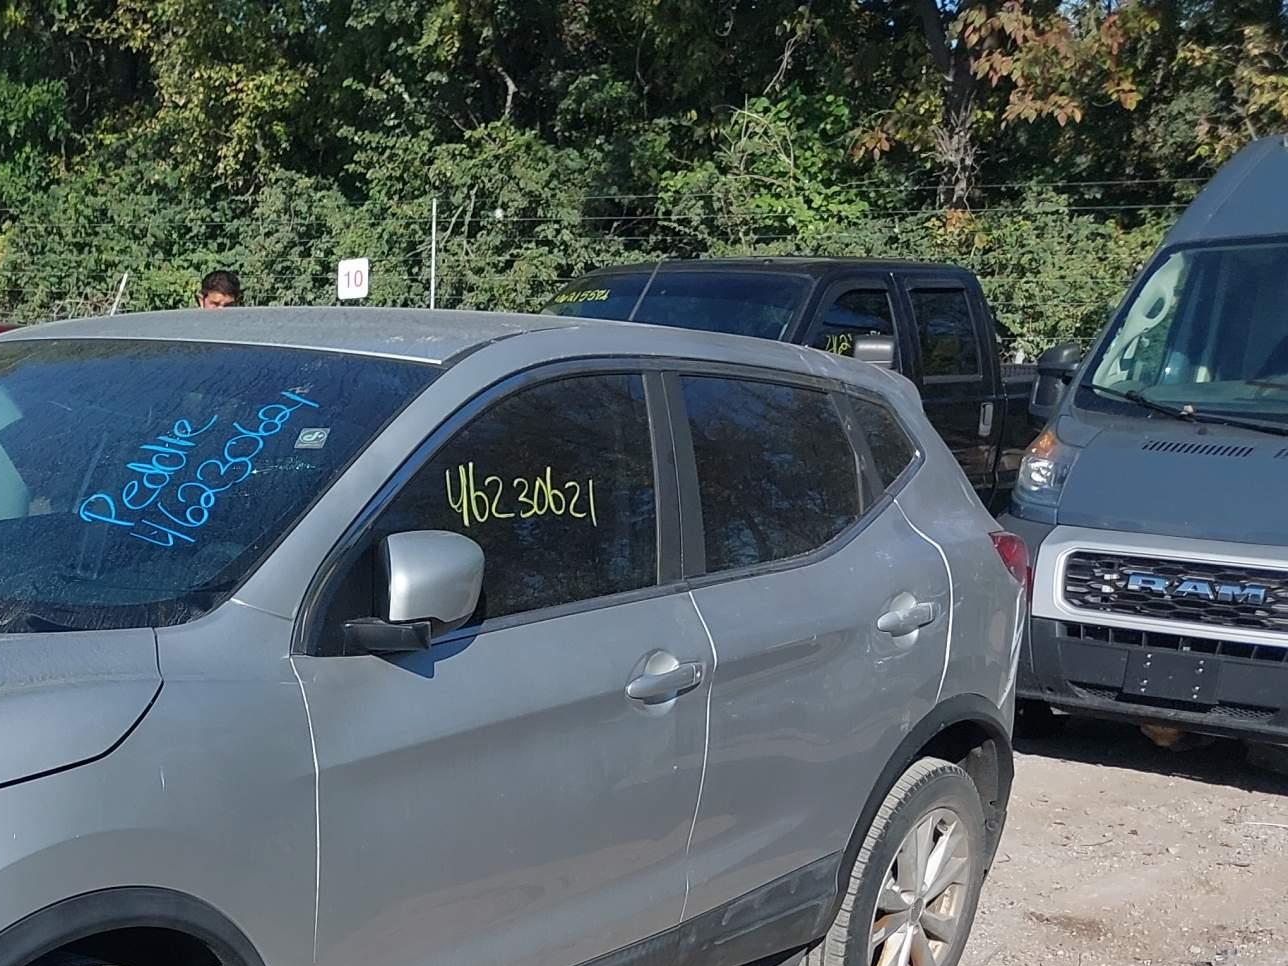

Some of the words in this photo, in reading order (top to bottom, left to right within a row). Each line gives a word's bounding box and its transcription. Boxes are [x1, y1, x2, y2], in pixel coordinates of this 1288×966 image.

[343, 270, 363, 288] 10
[130, 391, 320, 546] 46230621
[445, 461, 597, 527] 46230621
[1126, 571, 1266, 605] RAM
